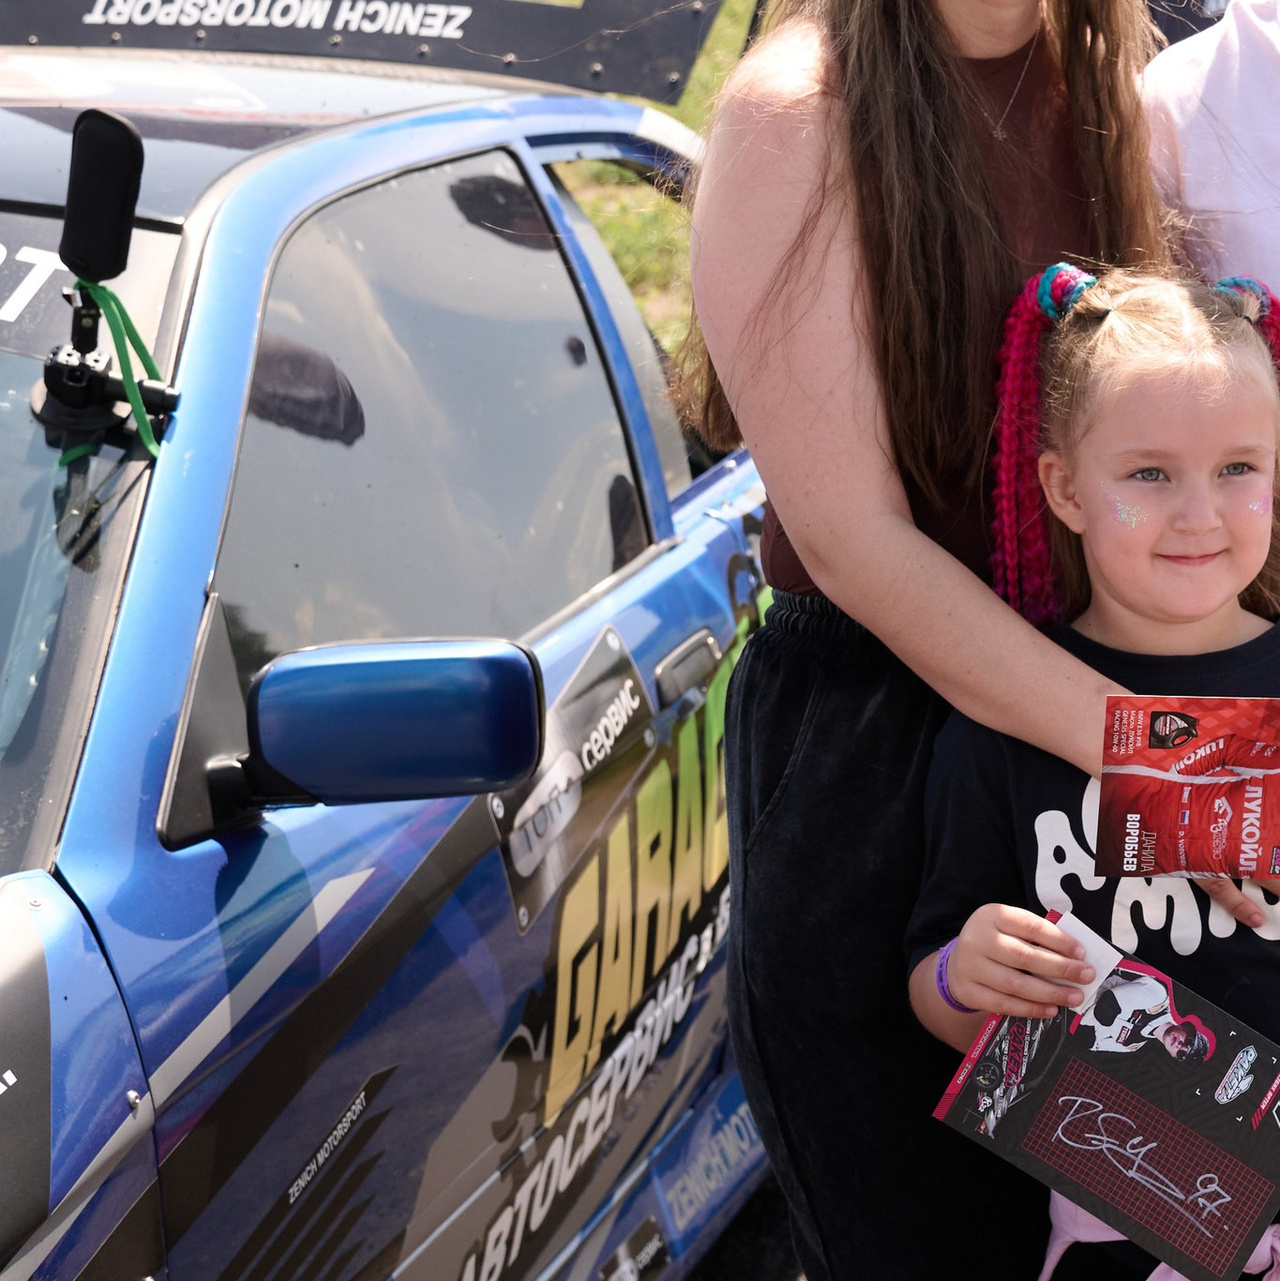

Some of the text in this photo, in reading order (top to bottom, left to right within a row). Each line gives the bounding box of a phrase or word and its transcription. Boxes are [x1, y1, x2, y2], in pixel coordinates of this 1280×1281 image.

[582, 679, 640, 771] сервис
[1113, 709, 1121, 731] RACING
[1121, 710, 1129, 733] GENESIS
[1123, 813, 1140, 872] ВОРОБЬЕВ
[1141, 830, 1157, 873] ДАНИЛА
[1239, 785, 1263, 872] ЛУКОЙЛ
[1216, 1047, 1258, 1102] РАКЕТА
[289, 1091, 367, 1204] ZENICH MOTORSPORT
